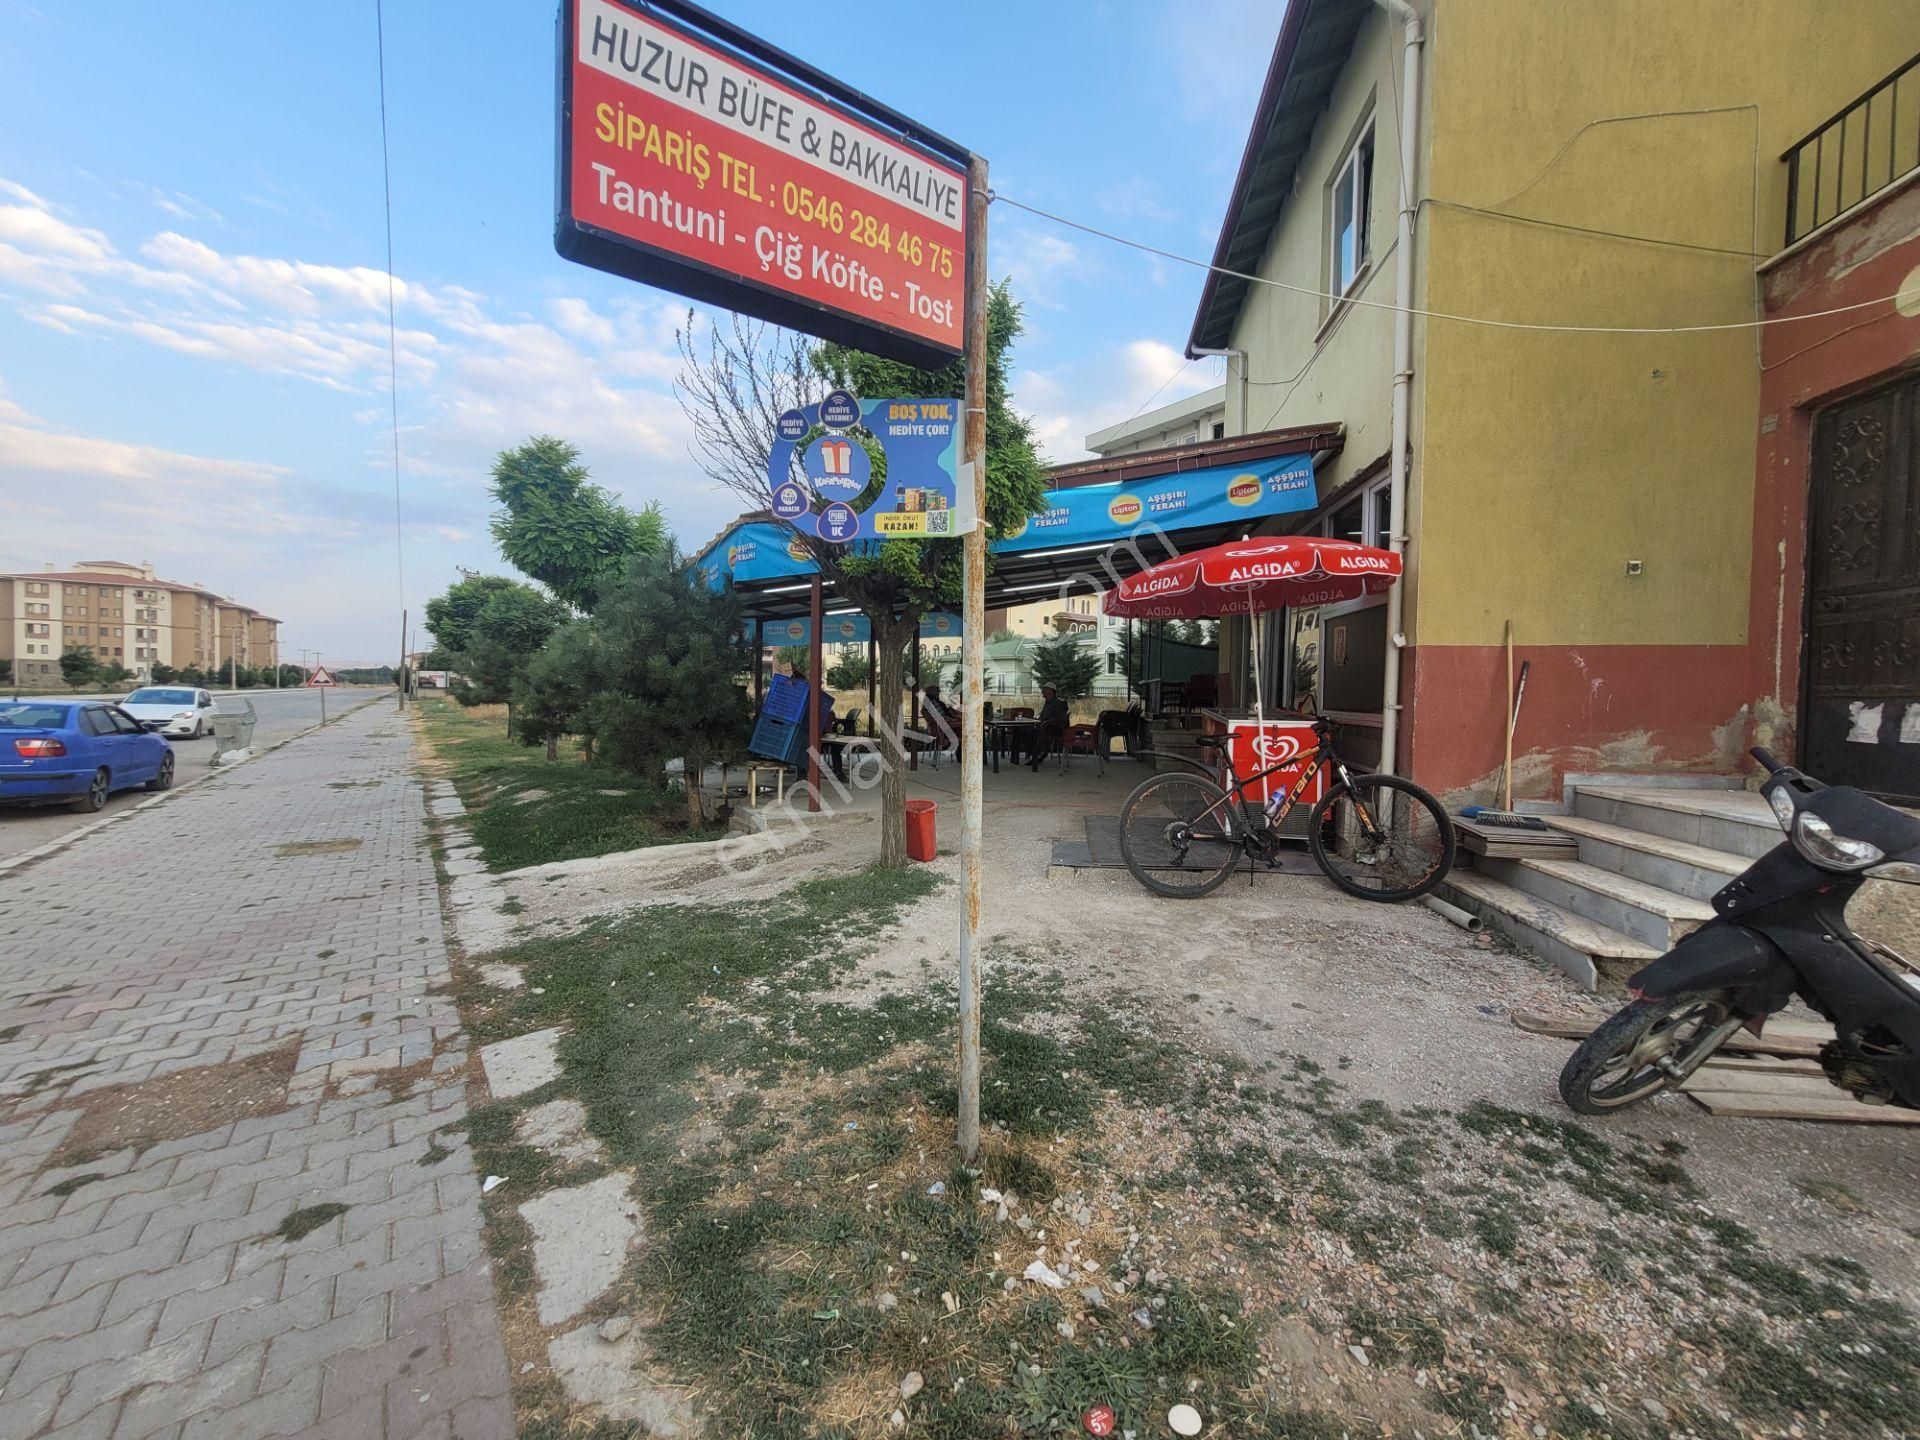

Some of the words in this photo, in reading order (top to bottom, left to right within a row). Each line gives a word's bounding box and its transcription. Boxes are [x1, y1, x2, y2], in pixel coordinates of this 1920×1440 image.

[591, 14, 709, 106] HUZUR
[718, 78, 793, 144] BÜFE
[799, 117, 821, 158] &
[829, 129, 959, 221] BAKKALİYE
[594, 101, 711, 190] SİPARİŞ
[717, 152, 763, 203] TEL
[769, 183, 776, 209] :
[783, 181, 844, 235] 0546
[850, 210, 891, 254] 284
[896, 231, 923, 266] 46
[928, 241, 953, 280] 75
[591, 161, 726, 247] Tantuni
[734, 233, 747, 244] -
[754, 225, 803, 281] Çiğ
[812, 245, 884, 302] Köfte
[890, 289, 900, 300] -
[904, 281, 953, 329] Tost
[828, 406, 850, 414] HEDİYE
[889, 403, 918, 422] BOŞ
[781, 418, 804, 427] HEDİYE
[889, 423, 924, 436] HEDİYE
[926, 424, 949, 437] ÇOK!
[1231, 484, 1260, 498] Lipton
[1112, 503, 1141, 516] Lipton
[831, 526, 844, 536] UC
[884, 522, 919, 531] KAZAN!
[1272, 761, 1318, 828] carraro
